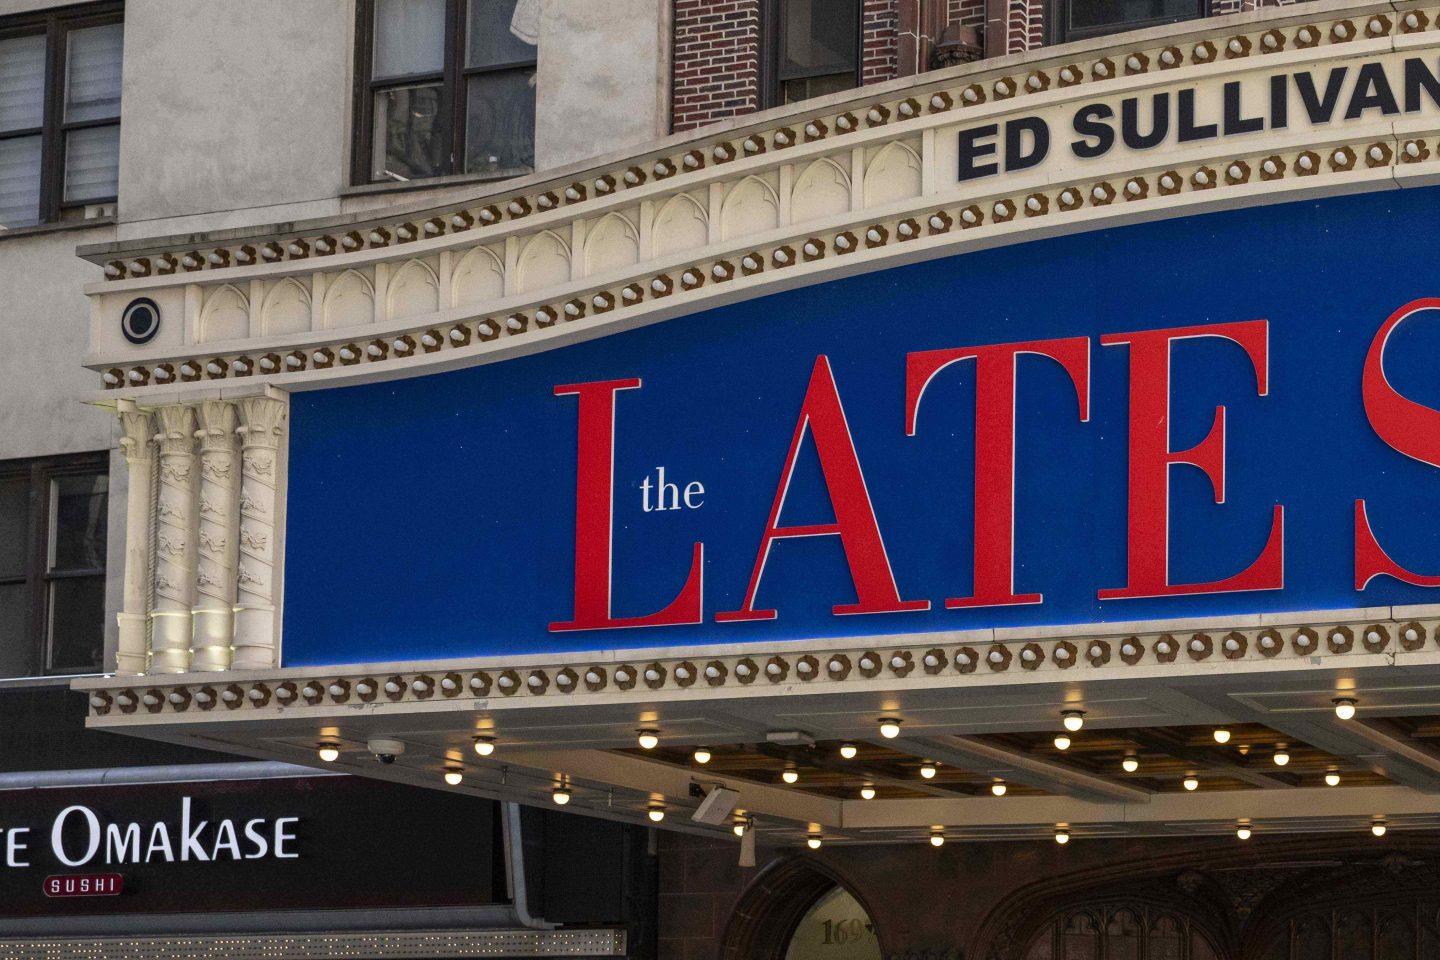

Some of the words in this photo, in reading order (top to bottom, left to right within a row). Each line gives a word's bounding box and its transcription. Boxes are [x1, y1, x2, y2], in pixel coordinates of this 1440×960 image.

[957, 115, 1050, 182] ED
[548, 318, 1286, 635] LATE
[639, 465, 706, 513] the
[51, 878, 115, 893] SUSHI
